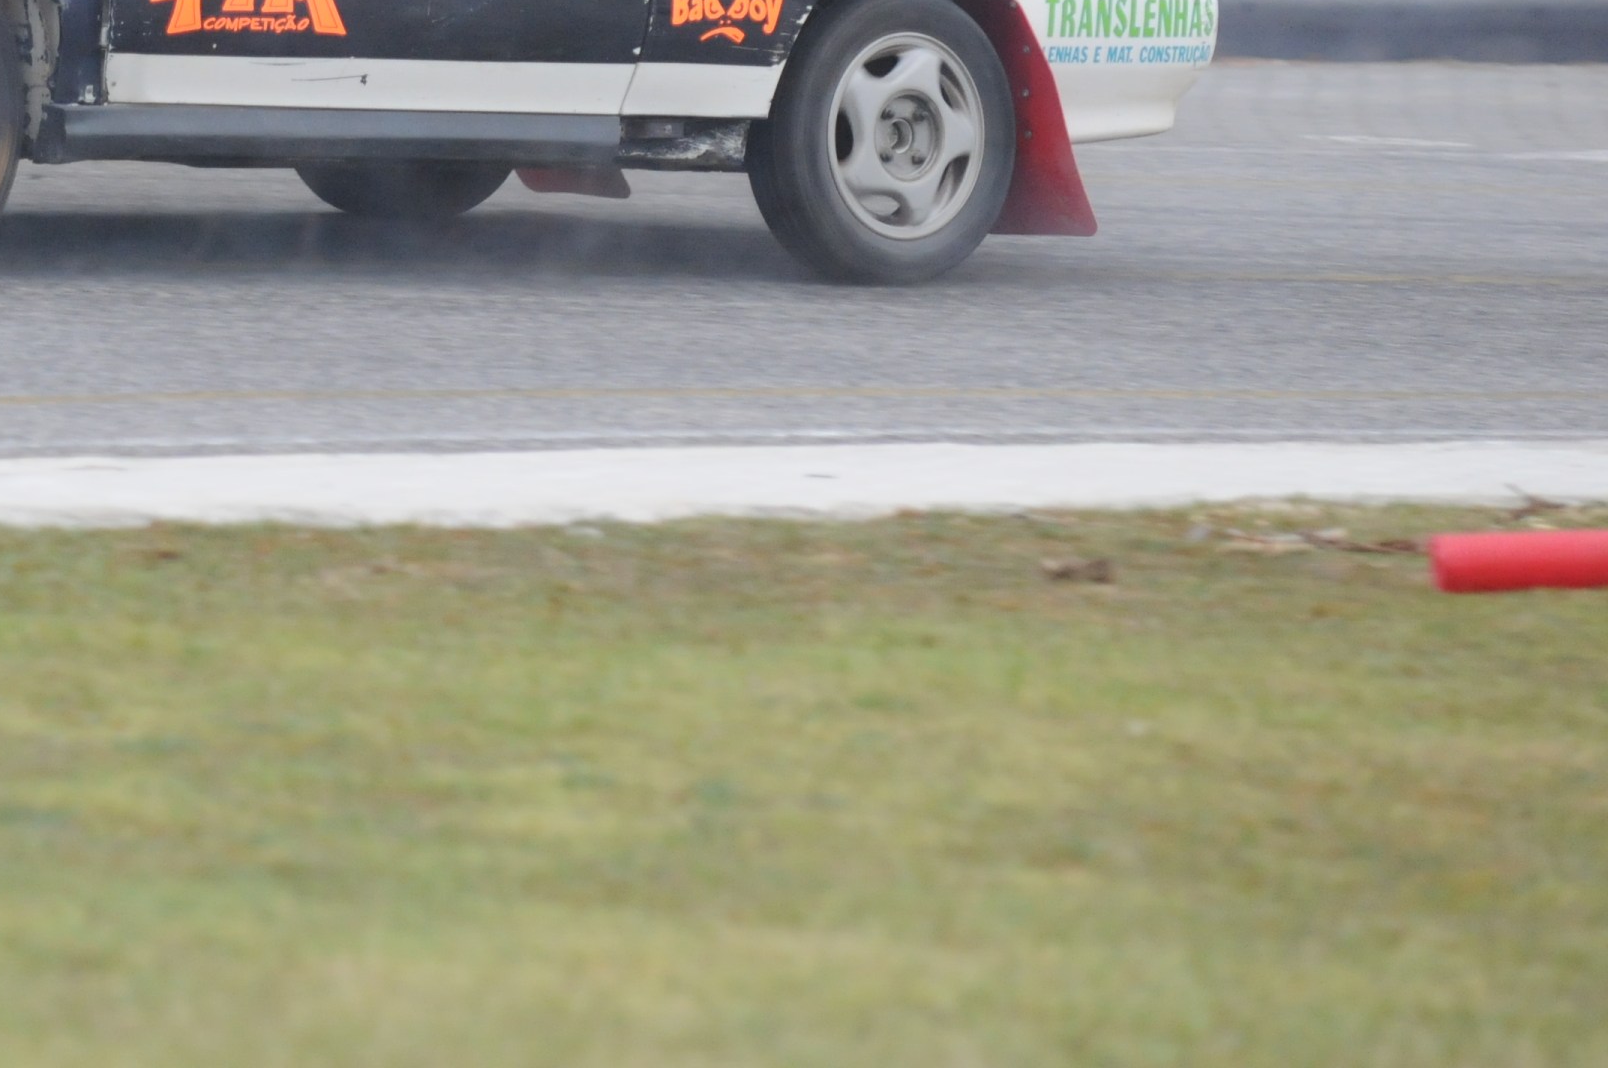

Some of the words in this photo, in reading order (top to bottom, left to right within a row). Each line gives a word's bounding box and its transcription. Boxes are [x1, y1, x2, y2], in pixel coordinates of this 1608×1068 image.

[202, 14, 311, 34] COMPETIÇÃO
[1093, 46, 1103, 64] E
[1106, 46, 1134, 64] MAT.
